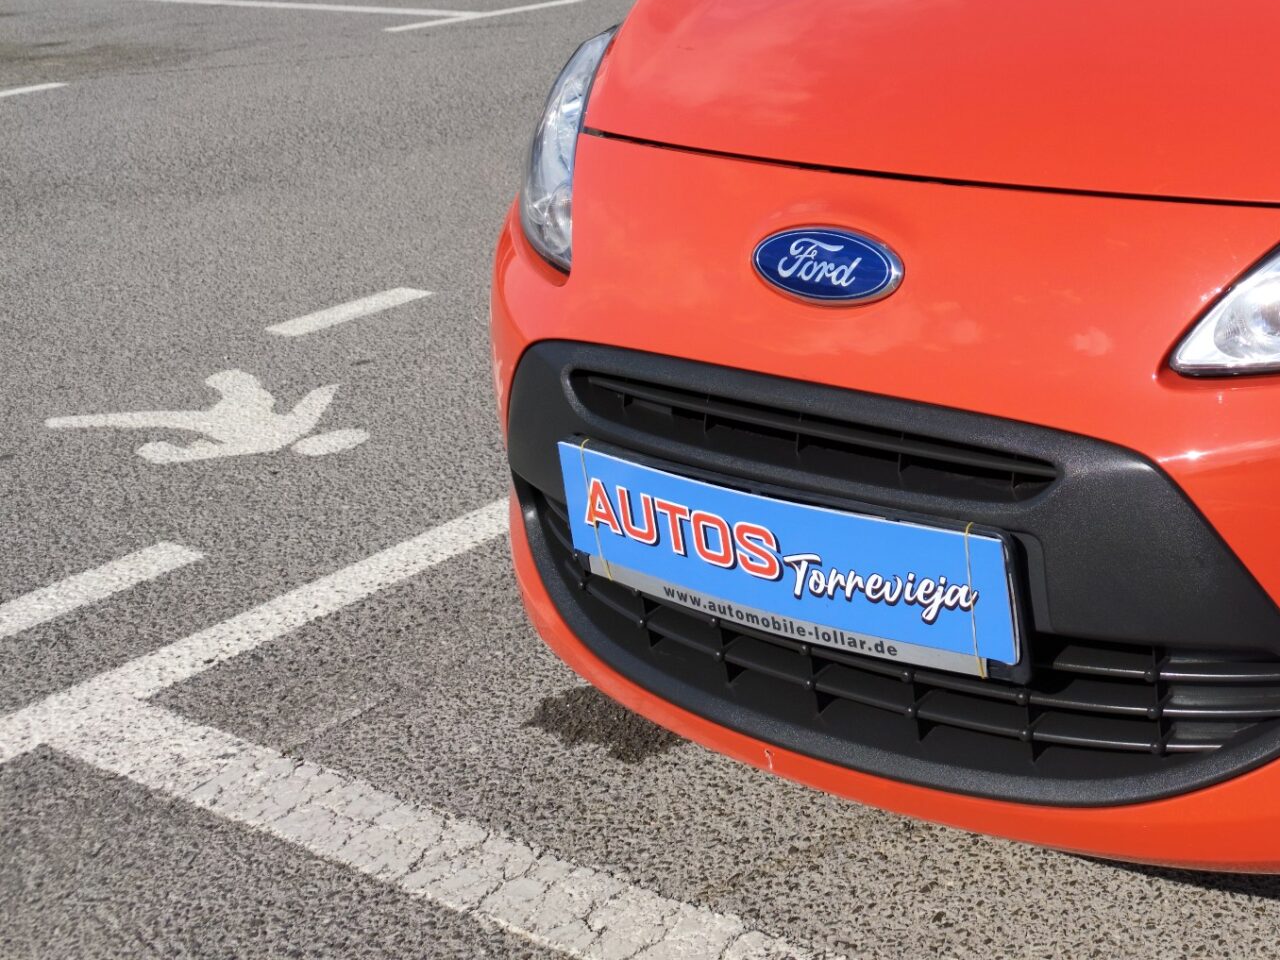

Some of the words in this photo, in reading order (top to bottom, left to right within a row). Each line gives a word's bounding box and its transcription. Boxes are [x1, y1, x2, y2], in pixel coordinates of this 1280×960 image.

[777, 237, 862, 287] Ford
[584, 477, 783, 581] AUTOS
[783, 553, 978, 625] Torrevieja
[663, 585, 898, 656] www.automobile-lollar.de
